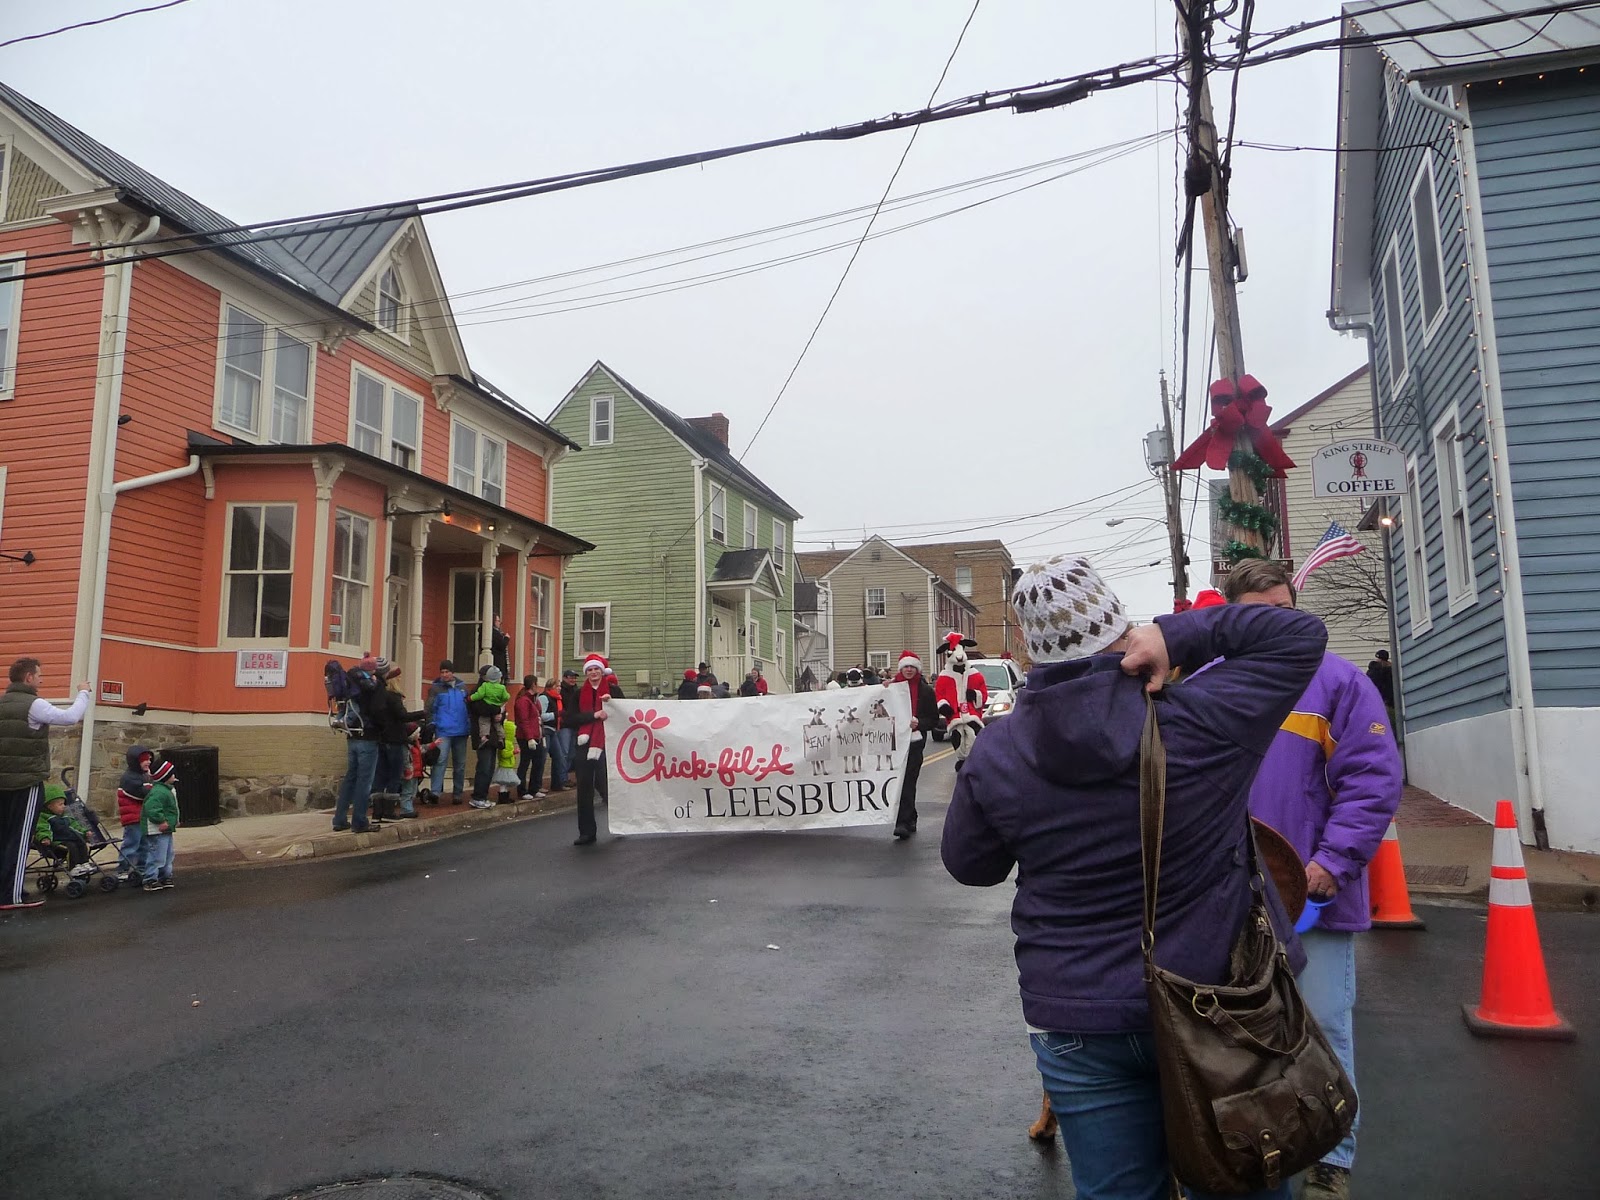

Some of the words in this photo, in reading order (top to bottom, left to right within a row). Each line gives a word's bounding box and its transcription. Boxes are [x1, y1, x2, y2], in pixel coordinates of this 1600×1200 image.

[1322, 444, 1349, 459] KING
[1352, 443, 1394, 456] STREET
[1326, 479, 1396, 494] COFFEE
[244, 661, 279, 669] LEASE
[251, 653, 273, 661] FOR
[809, 735, 827, 751] EAT
[839, 731, 862, 745] MOR
[616, 722, 794, 787] Chick-fil-A
[674, 799, 693, 819] of
